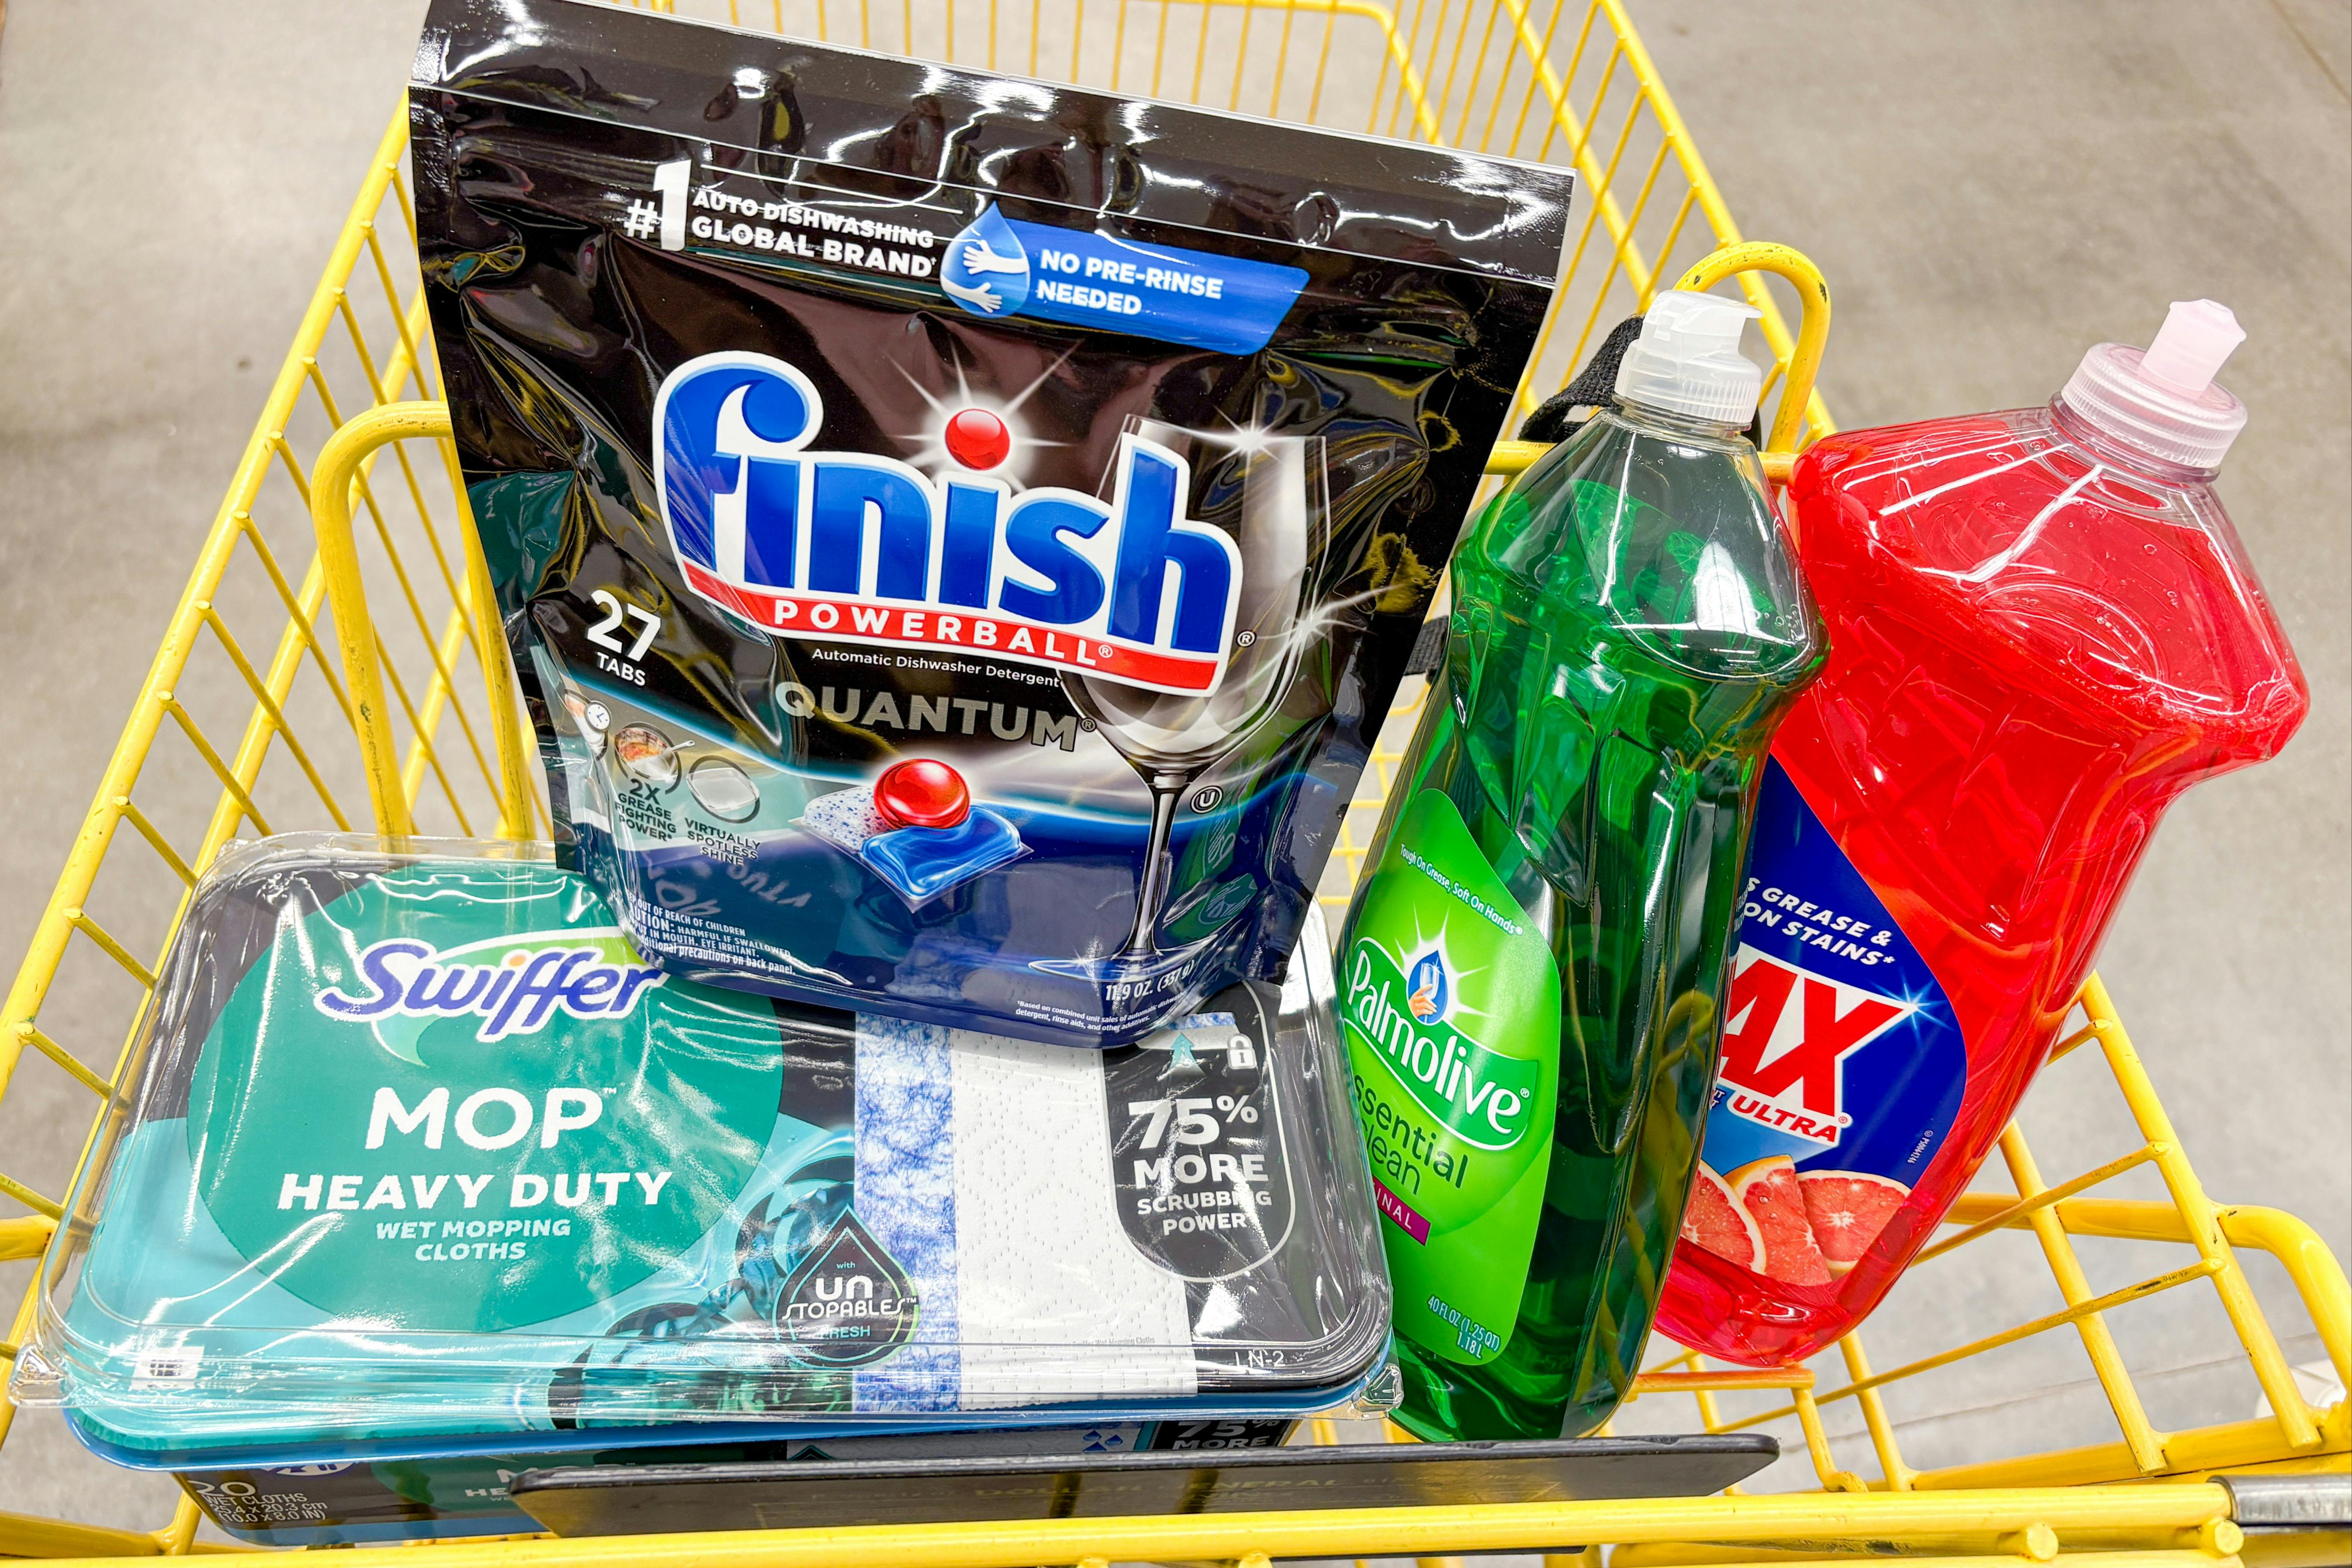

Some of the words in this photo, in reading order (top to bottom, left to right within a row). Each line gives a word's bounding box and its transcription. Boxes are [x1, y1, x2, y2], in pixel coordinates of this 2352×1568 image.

[624, 160, 692, 252] #1
[693, 189, 757, 217] AUTO
[763, 202, 934, 248] DISHWASHING
[692, 216, 815, 256] GLOBAL
[1040, 249, 1080, 274] NO
[1085, 257, 1223, 299] PRE-RINSE
[1037, 280, 1142, 315] NEEDED
[662, 362, 1232, 654] finish
[587, 589, 661, 662] 27
[597, 651, 646, 686] TABS
[812, 648, 891, 666] Automatic
[896, 656, 983, 674] Dishwasher
[986, 665, 1060, 688] Detergent
[618, 793, 671, 821] GREASE
[630, 778, 661, 806] 2X
[615, 801, 676, 833] FIGHTING
[685, 817, 761, 850] VIRTUALLY
[688, 830, 758, 860] SPOTLESS
[702, 846, 744, 866] SHINE
[1400, 844, 1416, 865] Tough
[1417, 856, 1426, 872] On
[1426, 863, 1451, 892] Grease,
[1452, 882, 1470, 903] Soft
[1471, 895, 1484, 913] On
[630, 903, 675, 933] AUTION:
[678, 926, 721, 941] HARMFUL
[723, 935, 731, 943] IF
[734, 937, 791, 956] SWALLOWED
[638, 899, 651, 912] OUT
[654, 905, 663, 917] OF
[665, 909, 691, 925] REACH
[693, 918, 703, 928] OF
[705, 921, 745, 937] CHILDREN
[1762, 887, 1871, 938] GREASE
[1871, 929, 1894, 948] &
[650, 929, 660, 939] IN
[662, 931, 698, 946] MOUTH.
[701, 938, 716, 949] EYE
[719, 941, 760, 957] IRRITANT.
[679, 946, 731, 964] precautions
[733, 955, 744, 965] on
[746, 955, 767, 969] back
[768, 962, 796, 975] panel.
[321, 942, 662, 1037] Swiffer
[1134, 982, 1153, 998] OZ.
[1157, 966, 1183, 992] (337
[1181, 959, 1195, 979] g)
[1016, 1008, 1051, 1022] detergent,
[1052, 1015, 1068, 1025] rinse
[1070, 1019, 1086, 1029] aids,
[1102, 1023, 1120, 1032] other
[1121, 1017, 1150, 1030] additives.
[1052, 1006, 1085, 1020] combined
[1101, 1015, 1118, 1023] sales
[1127, 1008, 1157, 1021] automatic
[1721, 958, 1905, 1117] AX
[1128, 1095, 1258, 1150] 75%
[1354, 1075, 1468, 1189] ssential
[1133, 1153, 1269, 1189] MORE
[277, 1173, 494, 1210] HEAVY
[511, 1171, 673, 1209] DUTY
[377, 1220, 437, 1240] WET
[442, 1218, 572, 1239] MOPPING
[1163, 1212, 1247, 1236] POWER
[415, 1242, 527, 1262] CLOTHS
[1136, 1336, 1155, 1344] Cloths
[1428, 1296, 1440, 1312] 40
[1439, 1303, 1448, 1320] FL
[1449, 1309, 1461, 1327] OZ
[1461, 1317, 1485, 1341] (1.25
[1484, 1332, 1500, 1352] QT)
[1457, 1331, 1477, 1354] 1.18
[1476, 1344, 1482, 1359] L
[1172, 1436, 1270, 1450] MORE
[1178, 1419, 1280, 1438] 75%
[186, 1480, 256, 1497] 20
[203, 1495, 236, 1506] WET
[242, 1493, 308, 1506] CLOTHS
[210, 1504, 246, 1514] 25.4
[248, 1506, 260, 1514] x
[262, 1503, 298, 1513] 20.3
[302, 1501, 328, 1510] cm
[219, 1513, 258, 1523] (10.0
[274, 1511, 300, 1521] 8.0
[301, 1509, 326, 1521] IN)
